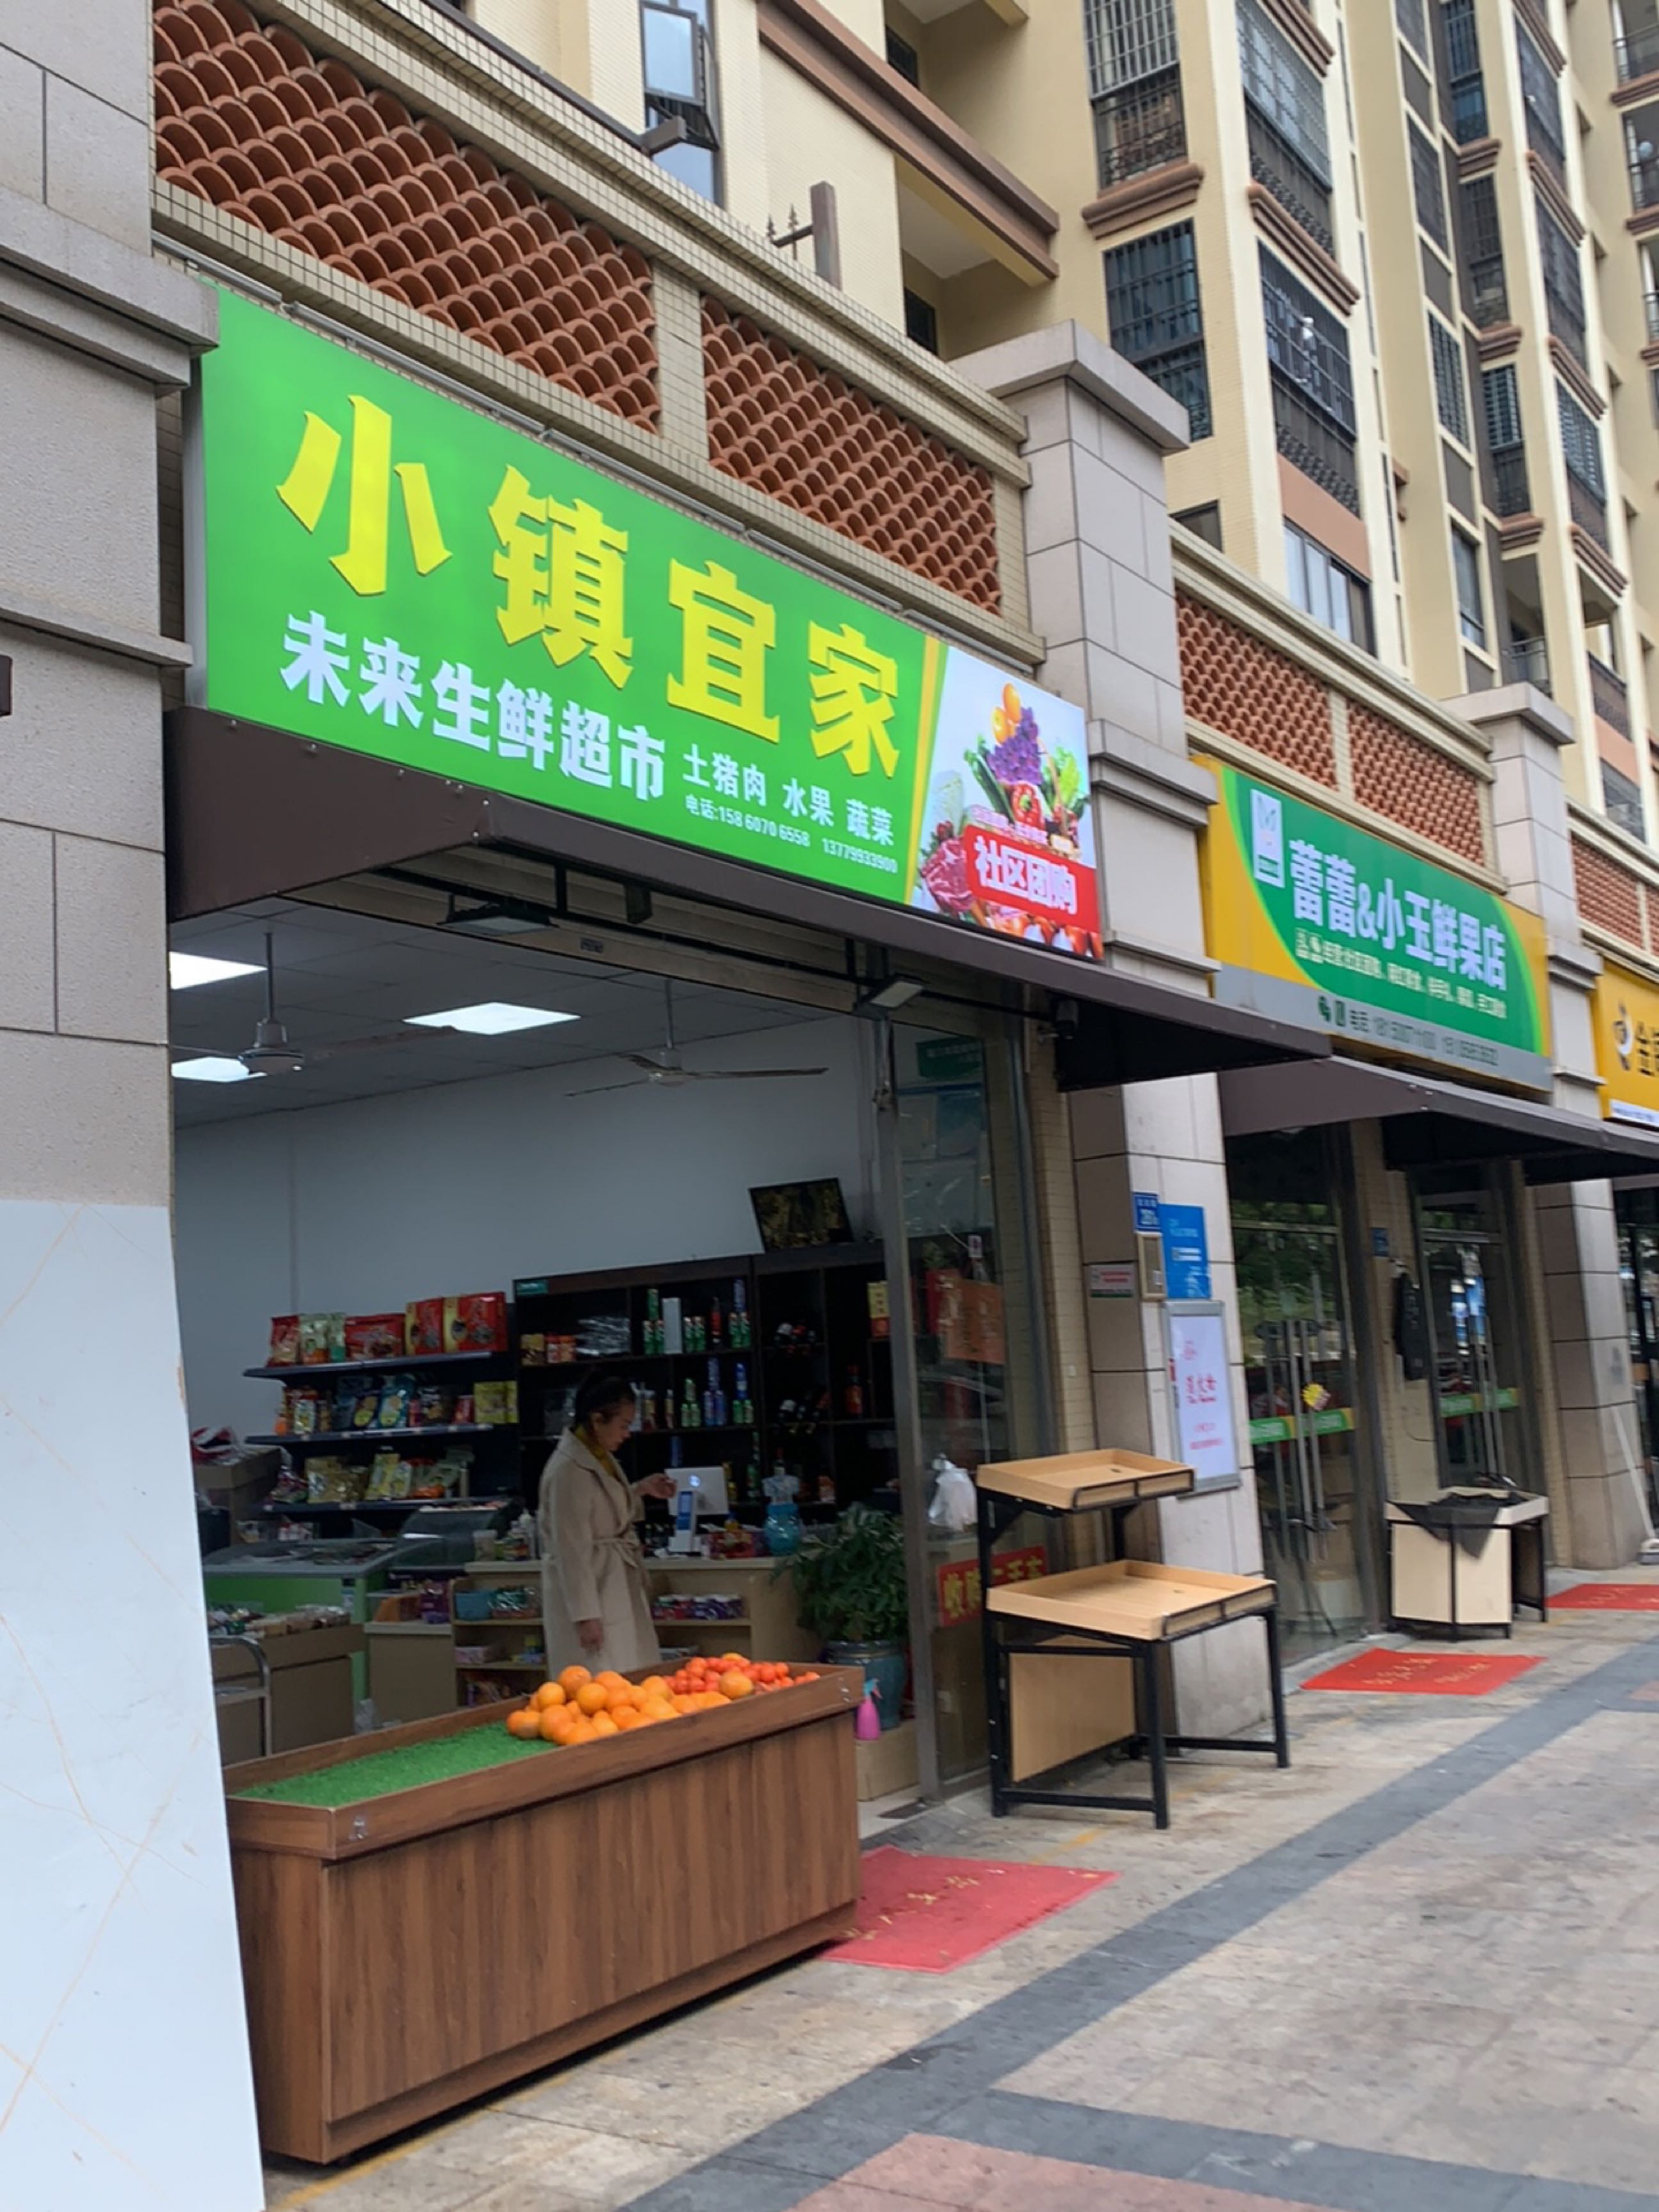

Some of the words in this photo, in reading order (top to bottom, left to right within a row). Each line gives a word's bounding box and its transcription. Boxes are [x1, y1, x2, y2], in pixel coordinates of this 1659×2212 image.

[276, 394, 899, 778] 小镇宜家
[280, 610, 665, 801] 未来生鲜超市
[682, 743, 766, 806] 土猪肉
[782, 777, 834, 827] 水果
[846, 798, 894, 846] 蔬菜
[974, 835, 1077, 915] 社区团购
[1289, 839, 1506, 991] 蕾蕾&小玉鲜果店
